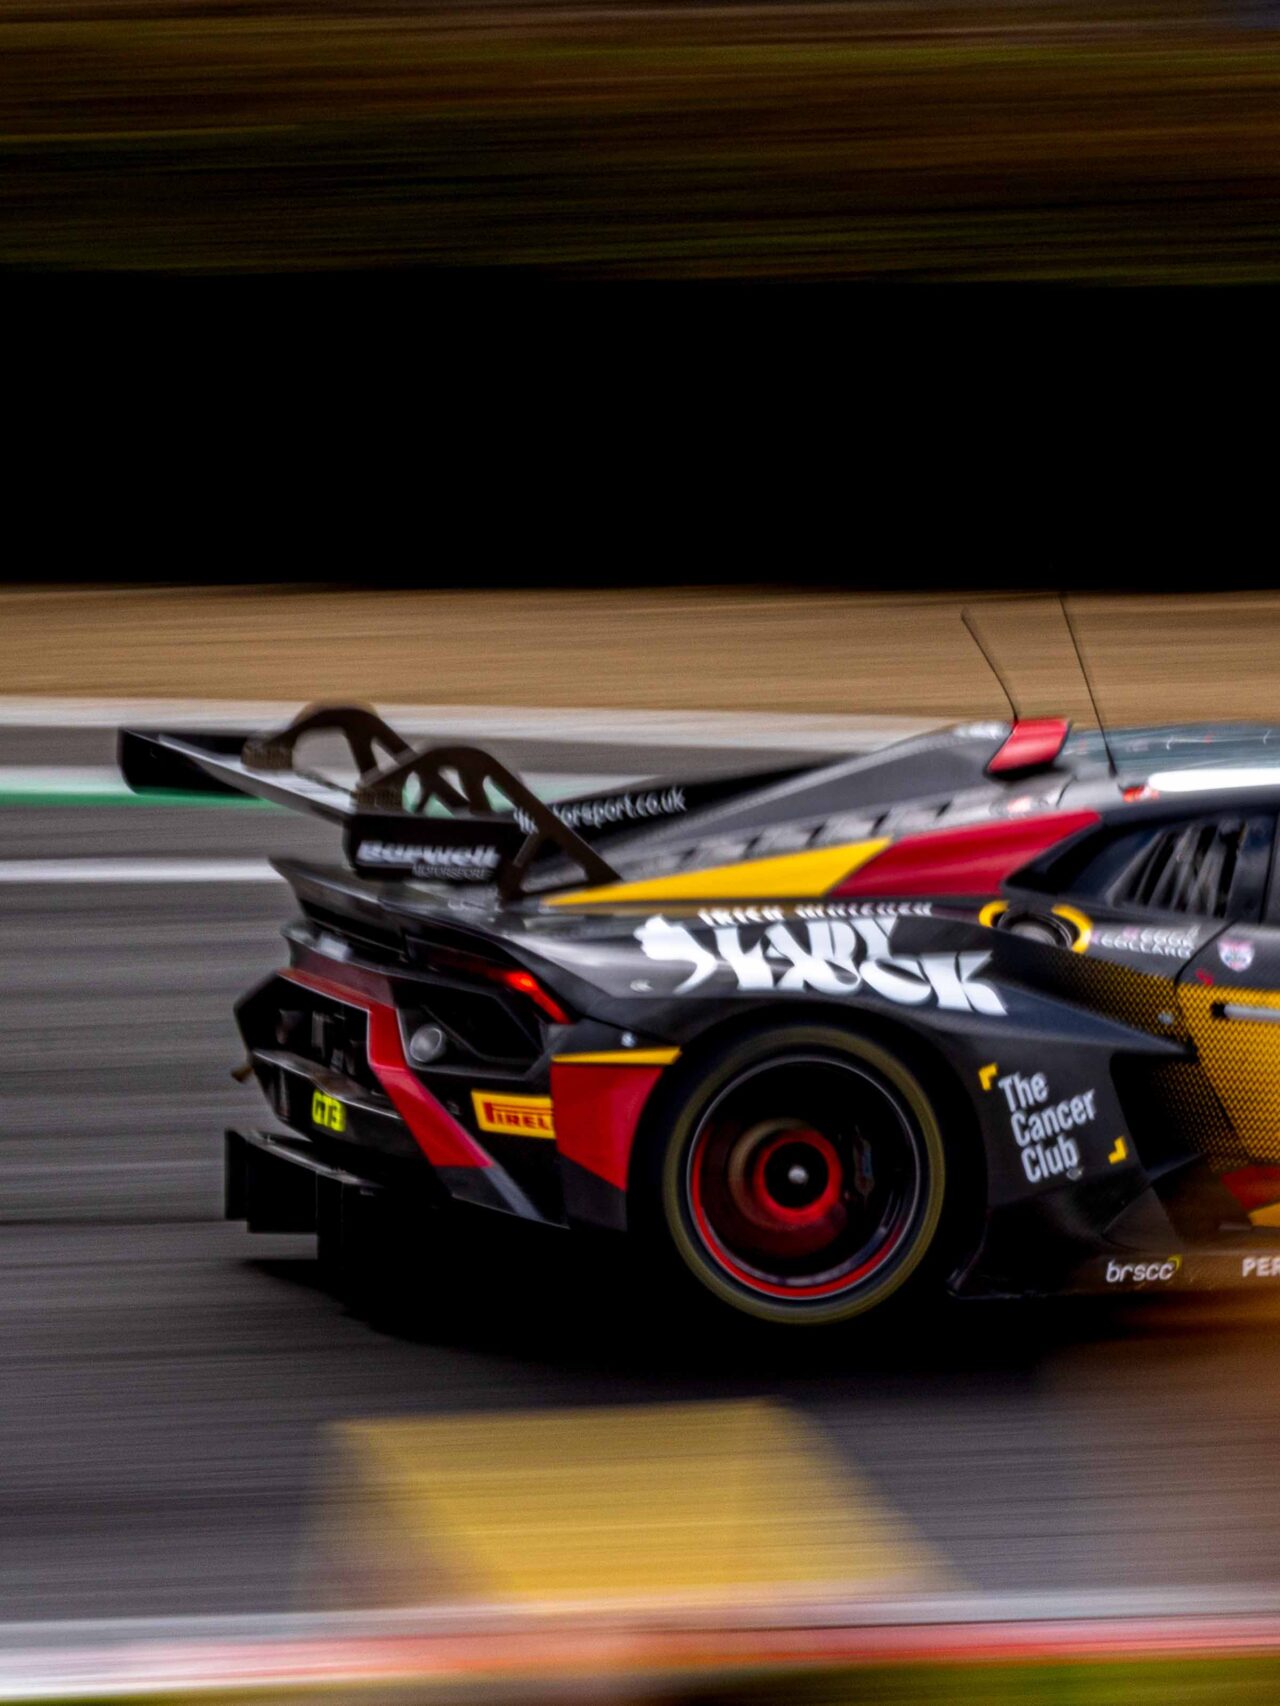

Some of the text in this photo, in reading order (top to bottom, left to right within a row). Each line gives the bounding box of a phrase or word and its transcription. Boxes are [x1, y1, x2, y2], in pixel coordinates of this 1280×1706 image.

[998, 1072, 1049, 1112] The
[1011, 1089, 1095, 1147] Cancer
[1021, 1133, 1080, 1183] Club
[1106, 1260, 1175, 1283] brscc
